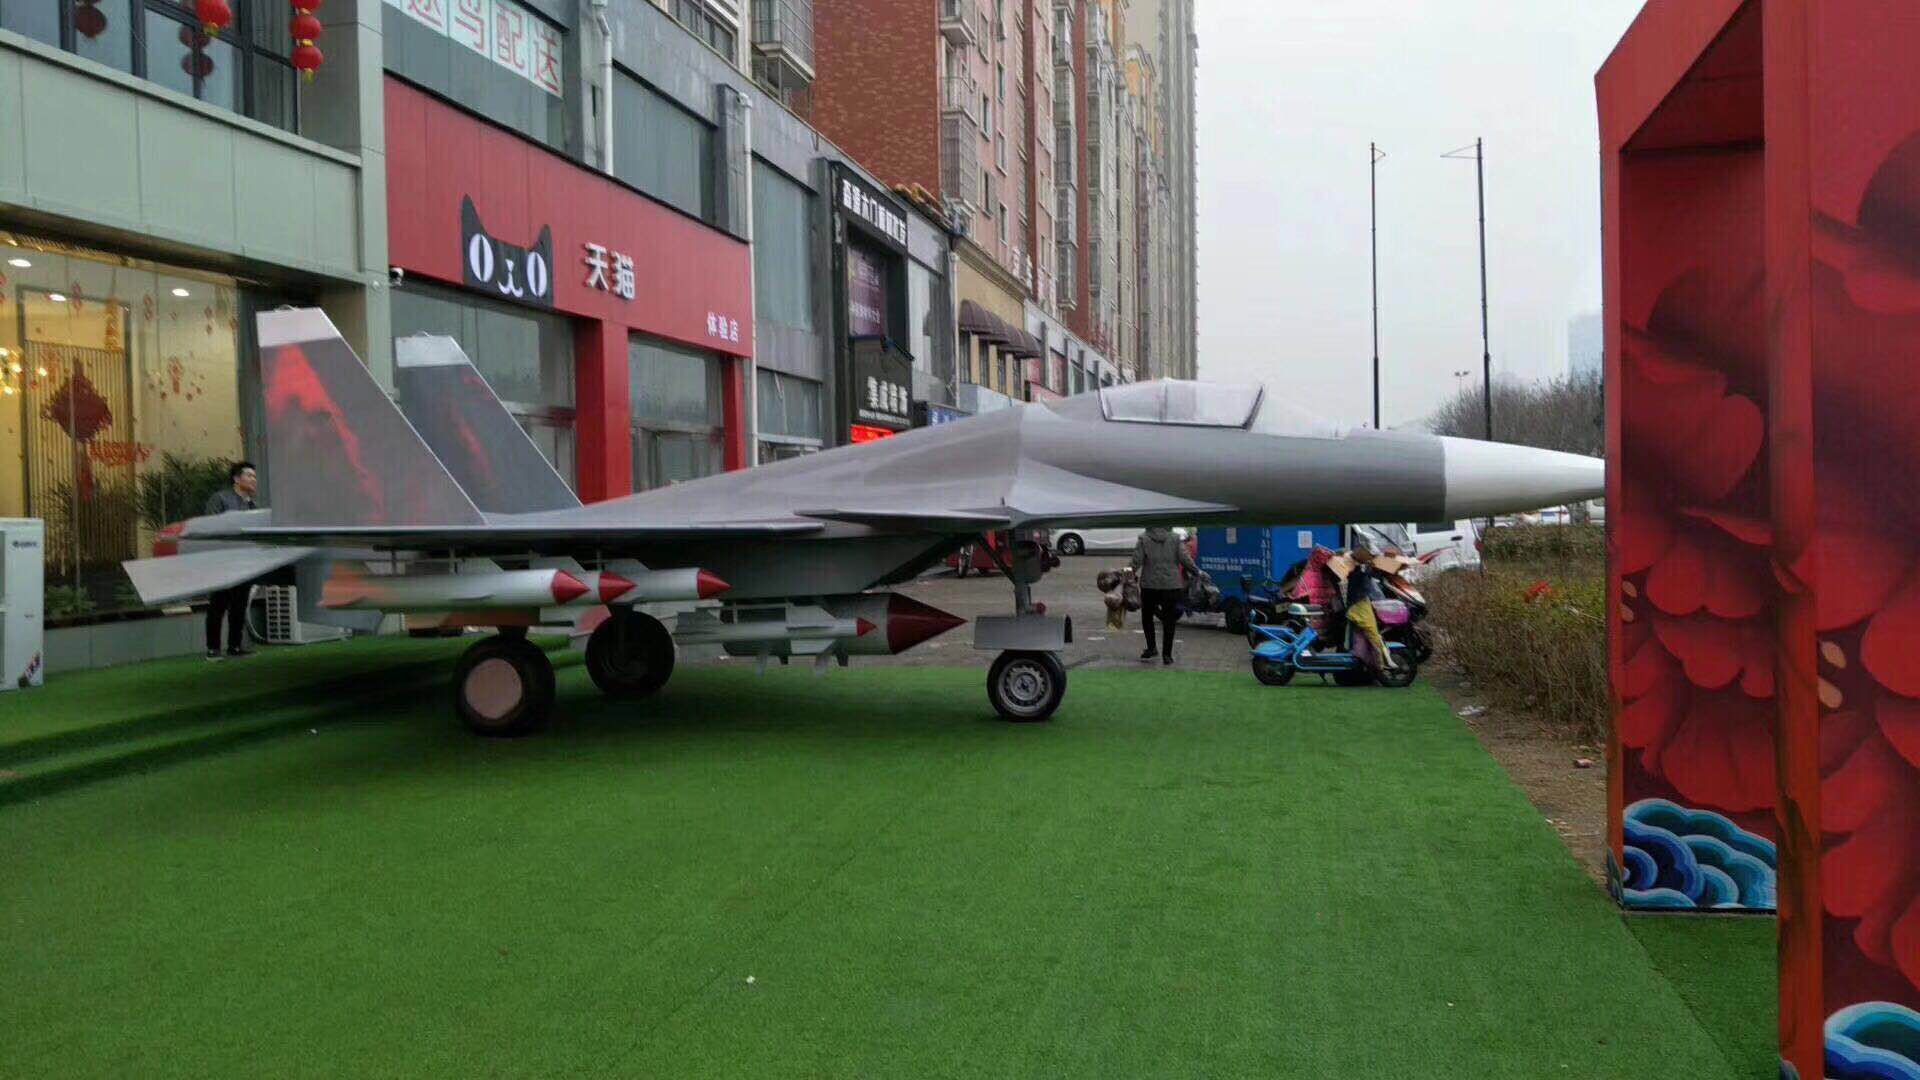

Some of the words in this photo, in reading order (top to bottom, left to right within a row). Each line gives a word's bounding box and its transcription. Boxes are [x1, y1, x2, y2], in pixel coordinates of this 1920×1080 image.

[584, 241, 636, 300] 天猫
[707, 311, 739, 343] 体验店
